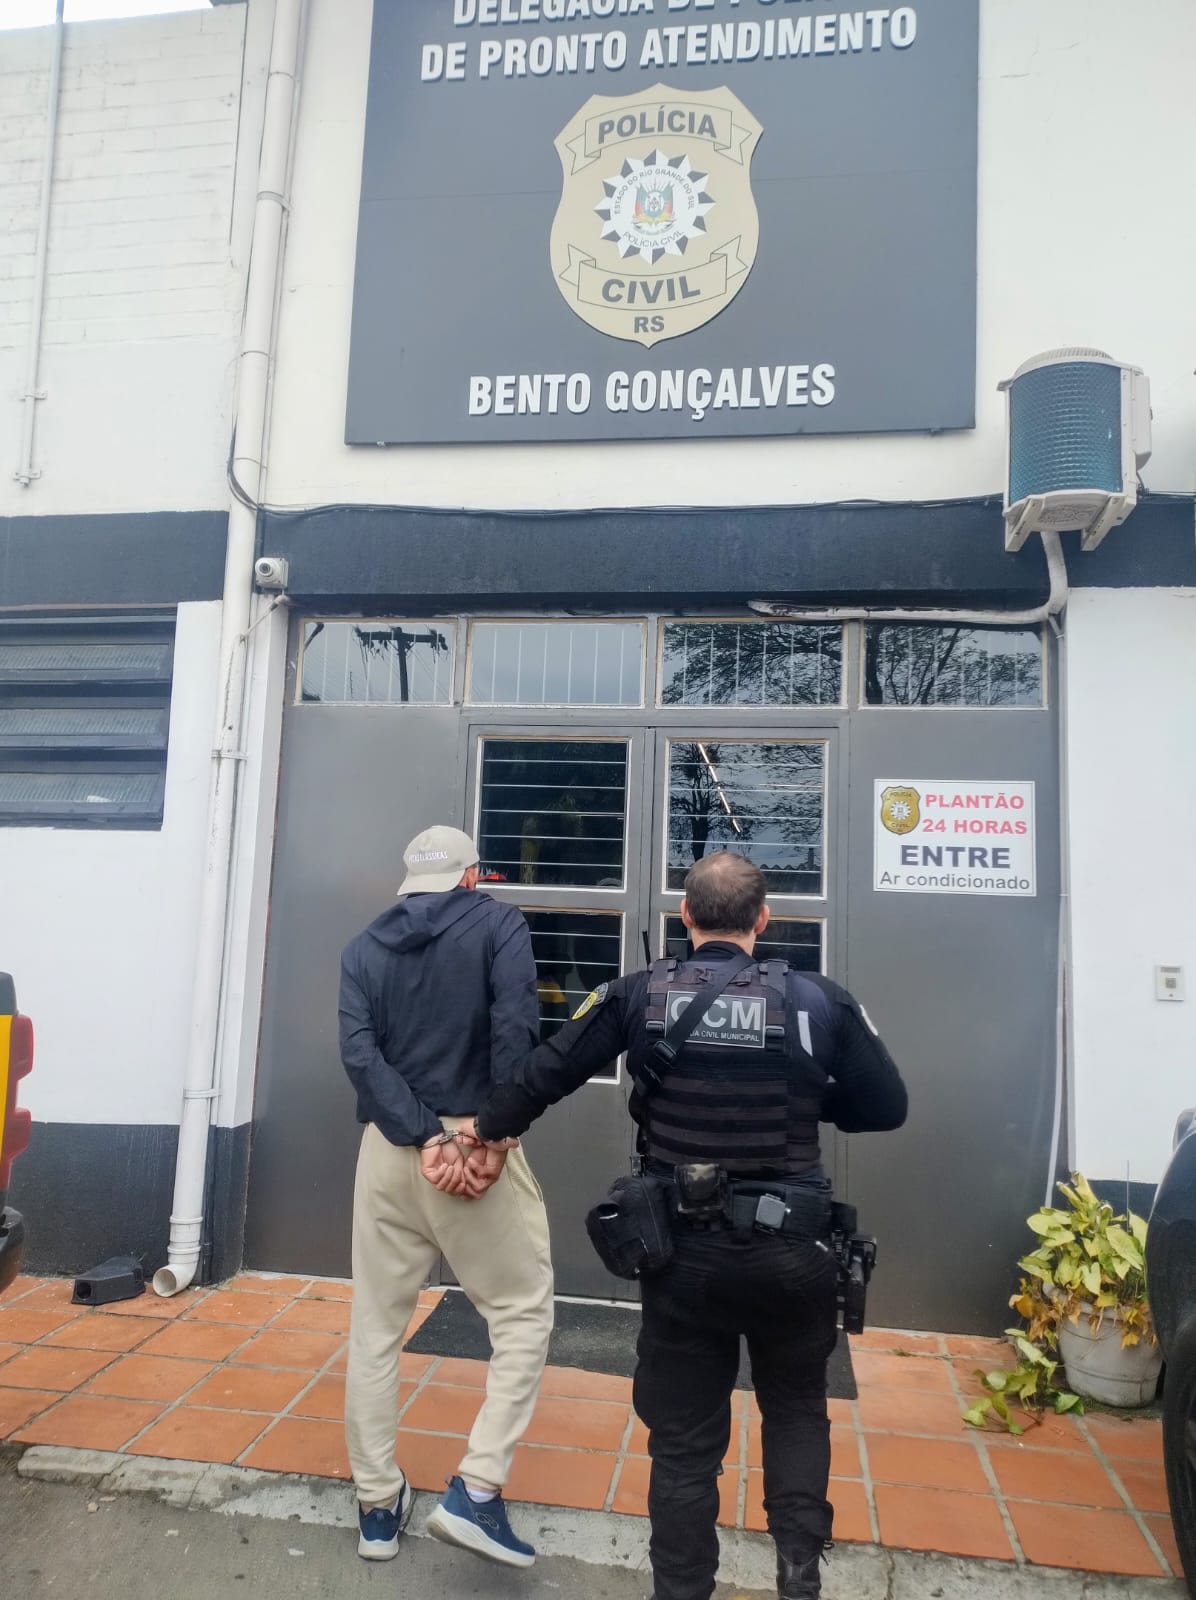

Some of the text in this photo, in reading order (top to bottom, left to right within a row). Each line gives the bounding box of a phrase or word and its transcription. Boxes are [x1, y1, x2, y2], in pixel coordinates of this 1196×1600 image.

[421, 7, 918, 82] DE PRONTO ATENDIMENTO
[598, 104, 717, 145] POLÍCIA
[614, 185, 628, 215] ESTADO
[627, 175, 638, 186] DO
[639, 169, 653, 178] RIO
[655, 168, 686, 184] GRANDE
[687, 193, 695, 210] SUL
[660, 230, 686, 246] CIVIL
[601, 275, 701, 304] CIVIL
[633, 315, 665, 334] RS
[468, 363, 835, 421] BENTO GONÇALVES
[925, 792, 1025, 810] PLANTÃO
[922, 818, 1028, 835] 24 HORAS
[900, 844, 1011, 869] ENTRE
[880, 871, 1030, 890] Ar condicionado
[700, 1030, 720, 1039] CIVIL
[721, 1032, 760, 1042] MUNICIPAL
